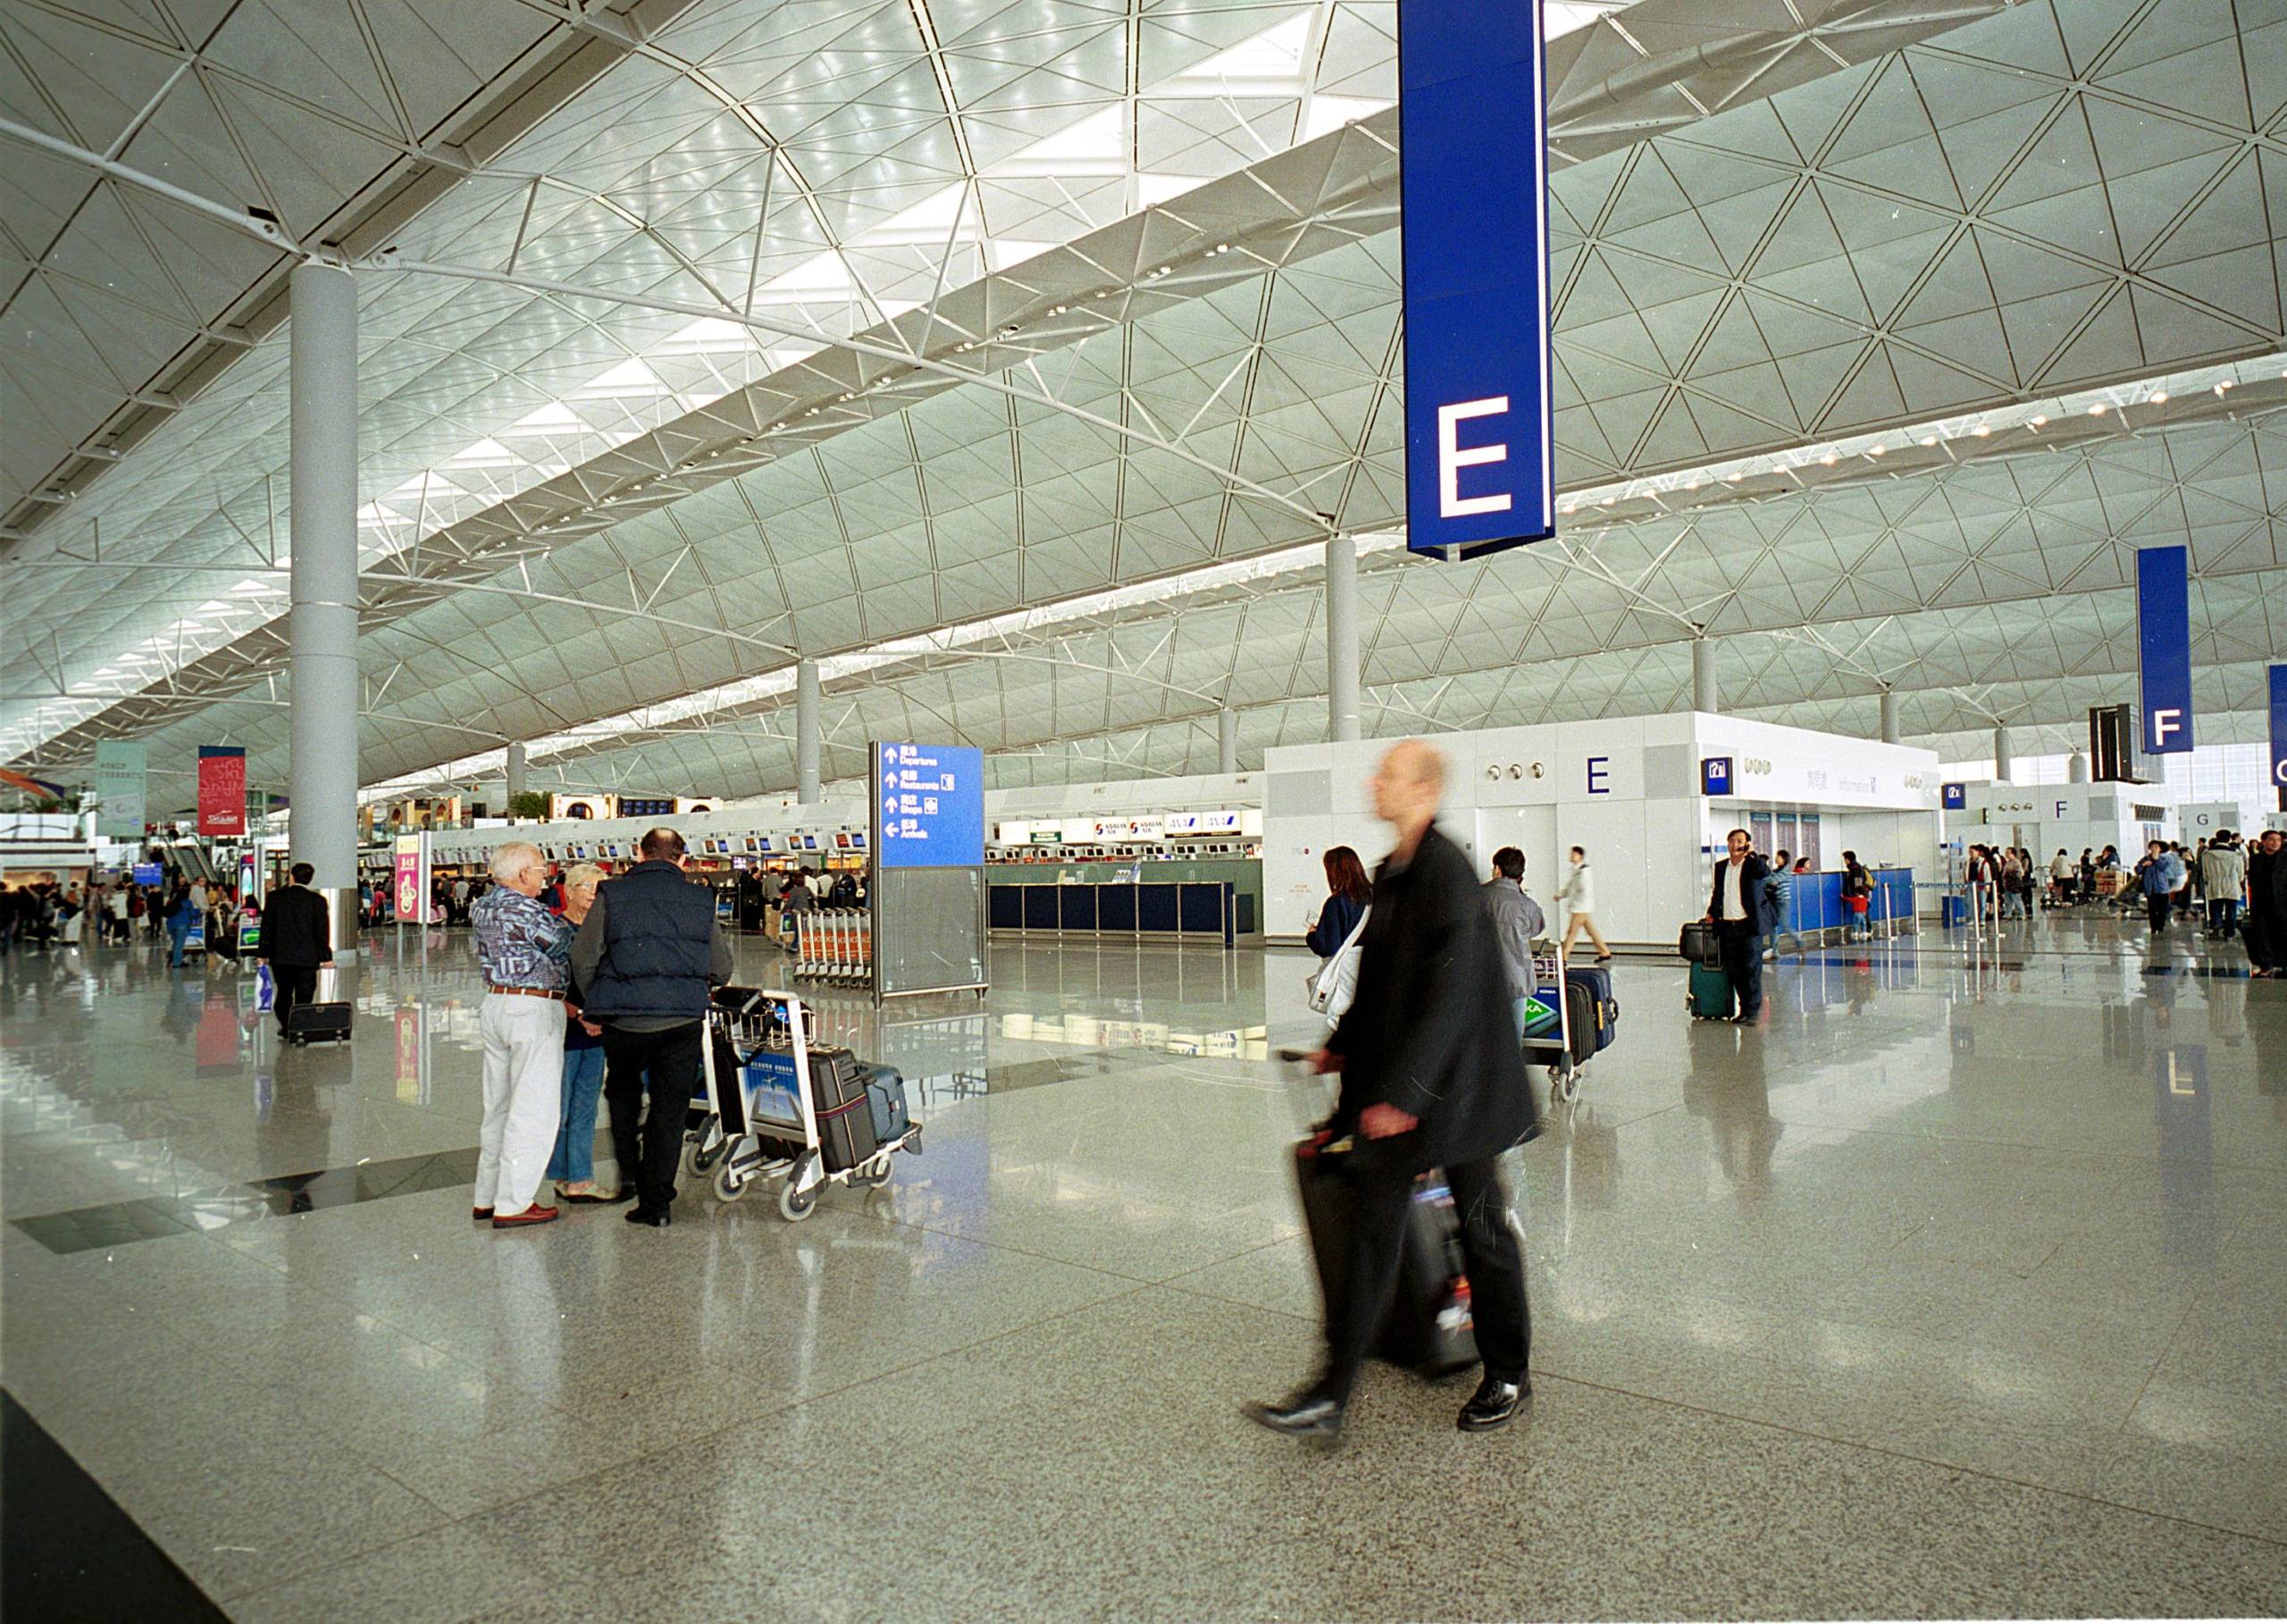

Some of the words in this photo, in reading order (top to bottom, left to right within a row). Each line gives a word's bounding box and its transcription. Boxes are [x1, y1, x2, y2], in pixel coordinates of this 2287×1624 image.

[1438, 396, 1512, 518] E
[2154, 708, 2181, 746] F
[900, 757, 937, 766] Departures
[1587, 757, 1610, 794] E
[900, 781, 940, 791] Restaurants
[901, 805, 923, 815] Shops
[2056, 800, 2067, 819] F
[2196, 813, 2209, 826] G
[901, 829, 928, 839] Arrivals
